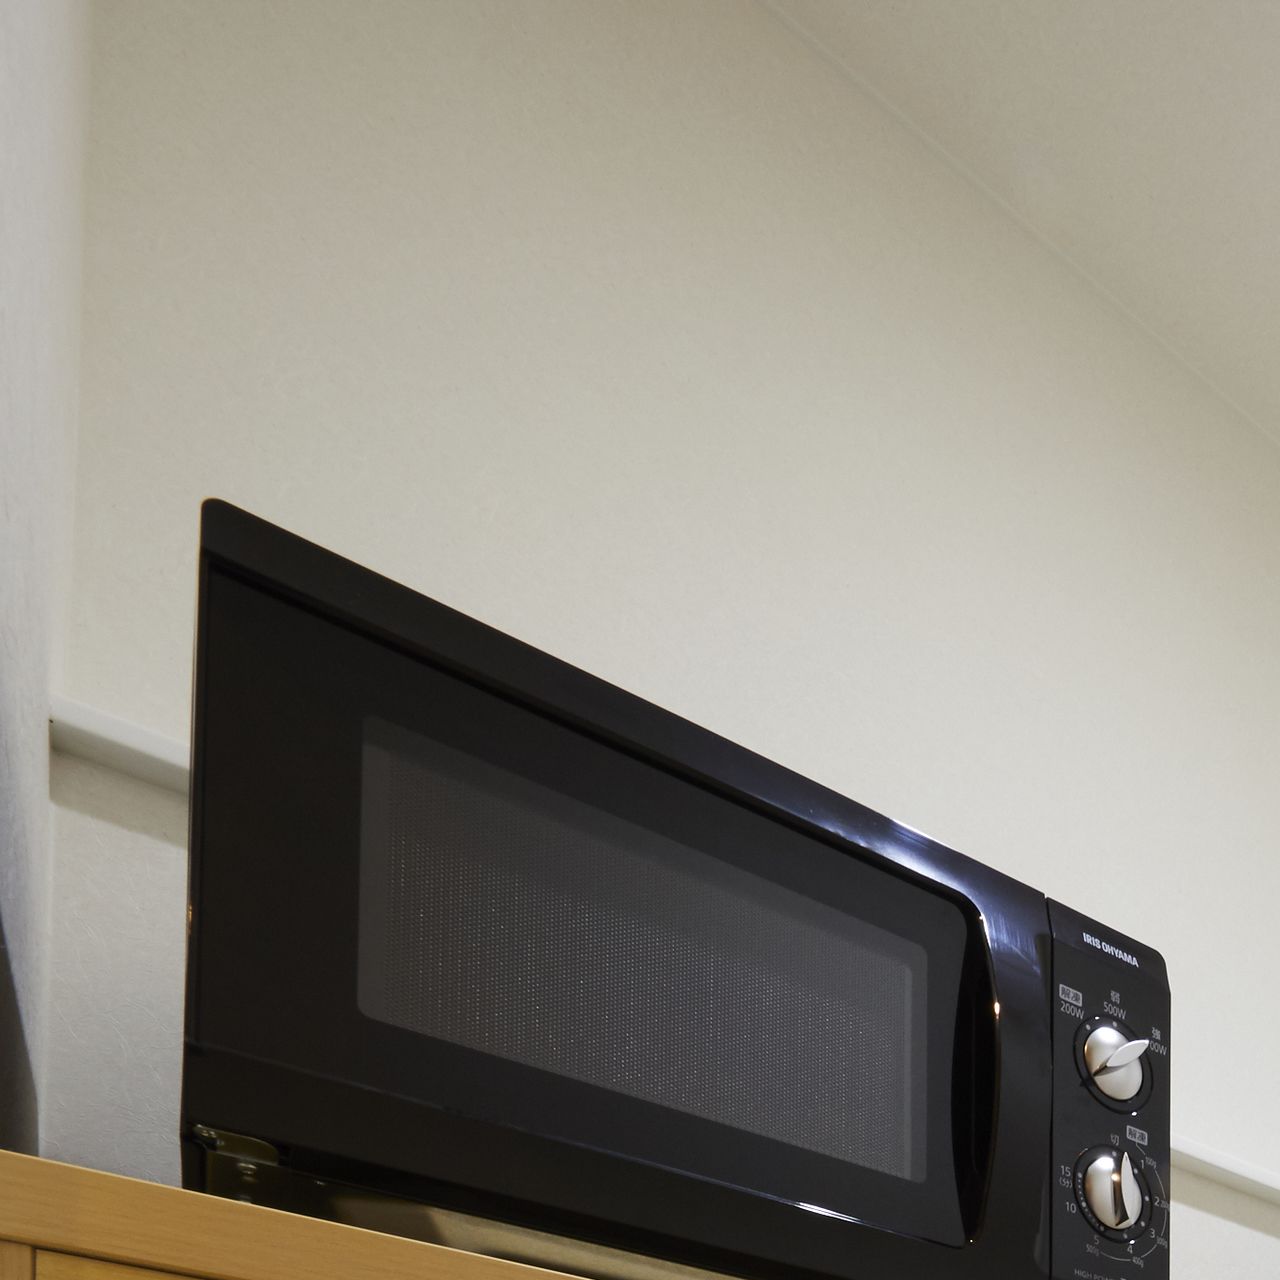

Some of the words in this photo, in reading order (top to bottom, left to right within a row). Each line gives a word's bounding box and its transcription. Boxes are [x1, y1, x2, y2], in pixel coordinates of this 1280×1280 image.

[1083, 932, 1101, 950] IRIS
[1102, 941, 1139, 968] OHYAMA
[1061, 986, 1081, 1004] 解凍
[1060, 1001, 1084, 1020] 200W
[1103, 1002, 1126, 1020] 500W
[1149, 1040, 1167, 1056] 00W
[1140, 1160, 1145, 1169] 1
[1060, 1165, 1071, 1177] 15
[1154, 1196, 1160, 1207] 2
[1065, 1202, 1077, 1213] 10
[1150, 1228, 1155, 1238] 3
[1094, 1235, 1100, 1245] 5
[1127, 1245, 1133, 1254] 4
[1074, 1269, 1092, 1280] HIGH
